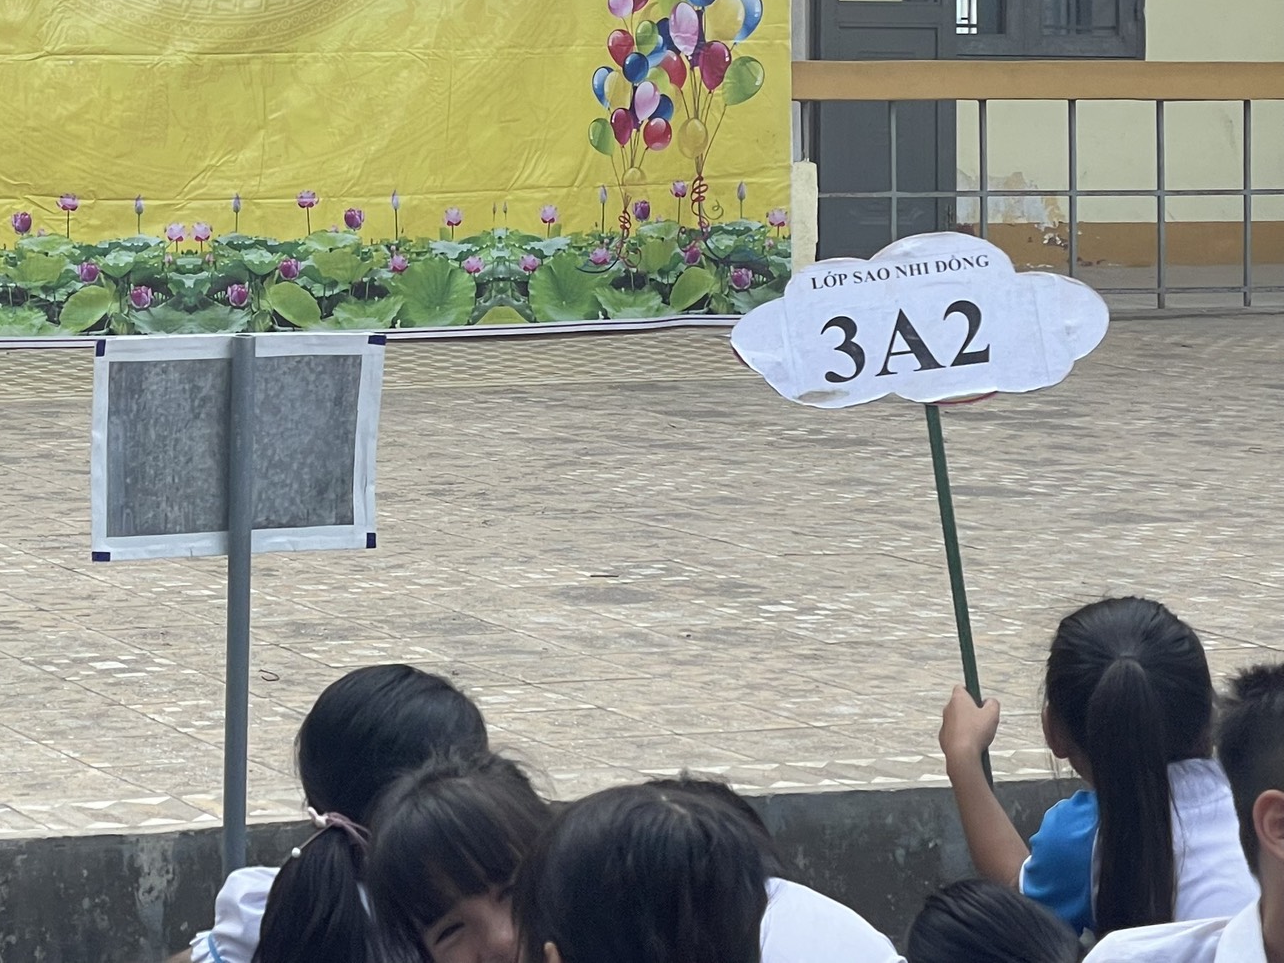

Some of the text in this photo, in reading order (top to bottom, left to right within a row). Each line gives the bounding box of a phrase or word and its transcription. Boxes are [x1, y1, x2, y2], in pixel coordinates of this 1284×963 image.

[811, 270, 848, 289] LỚP
[853, 267, 890, 284] SAO
[895, 262, 930, 278] NHI
[820, 299, 991, 383] 3A2
